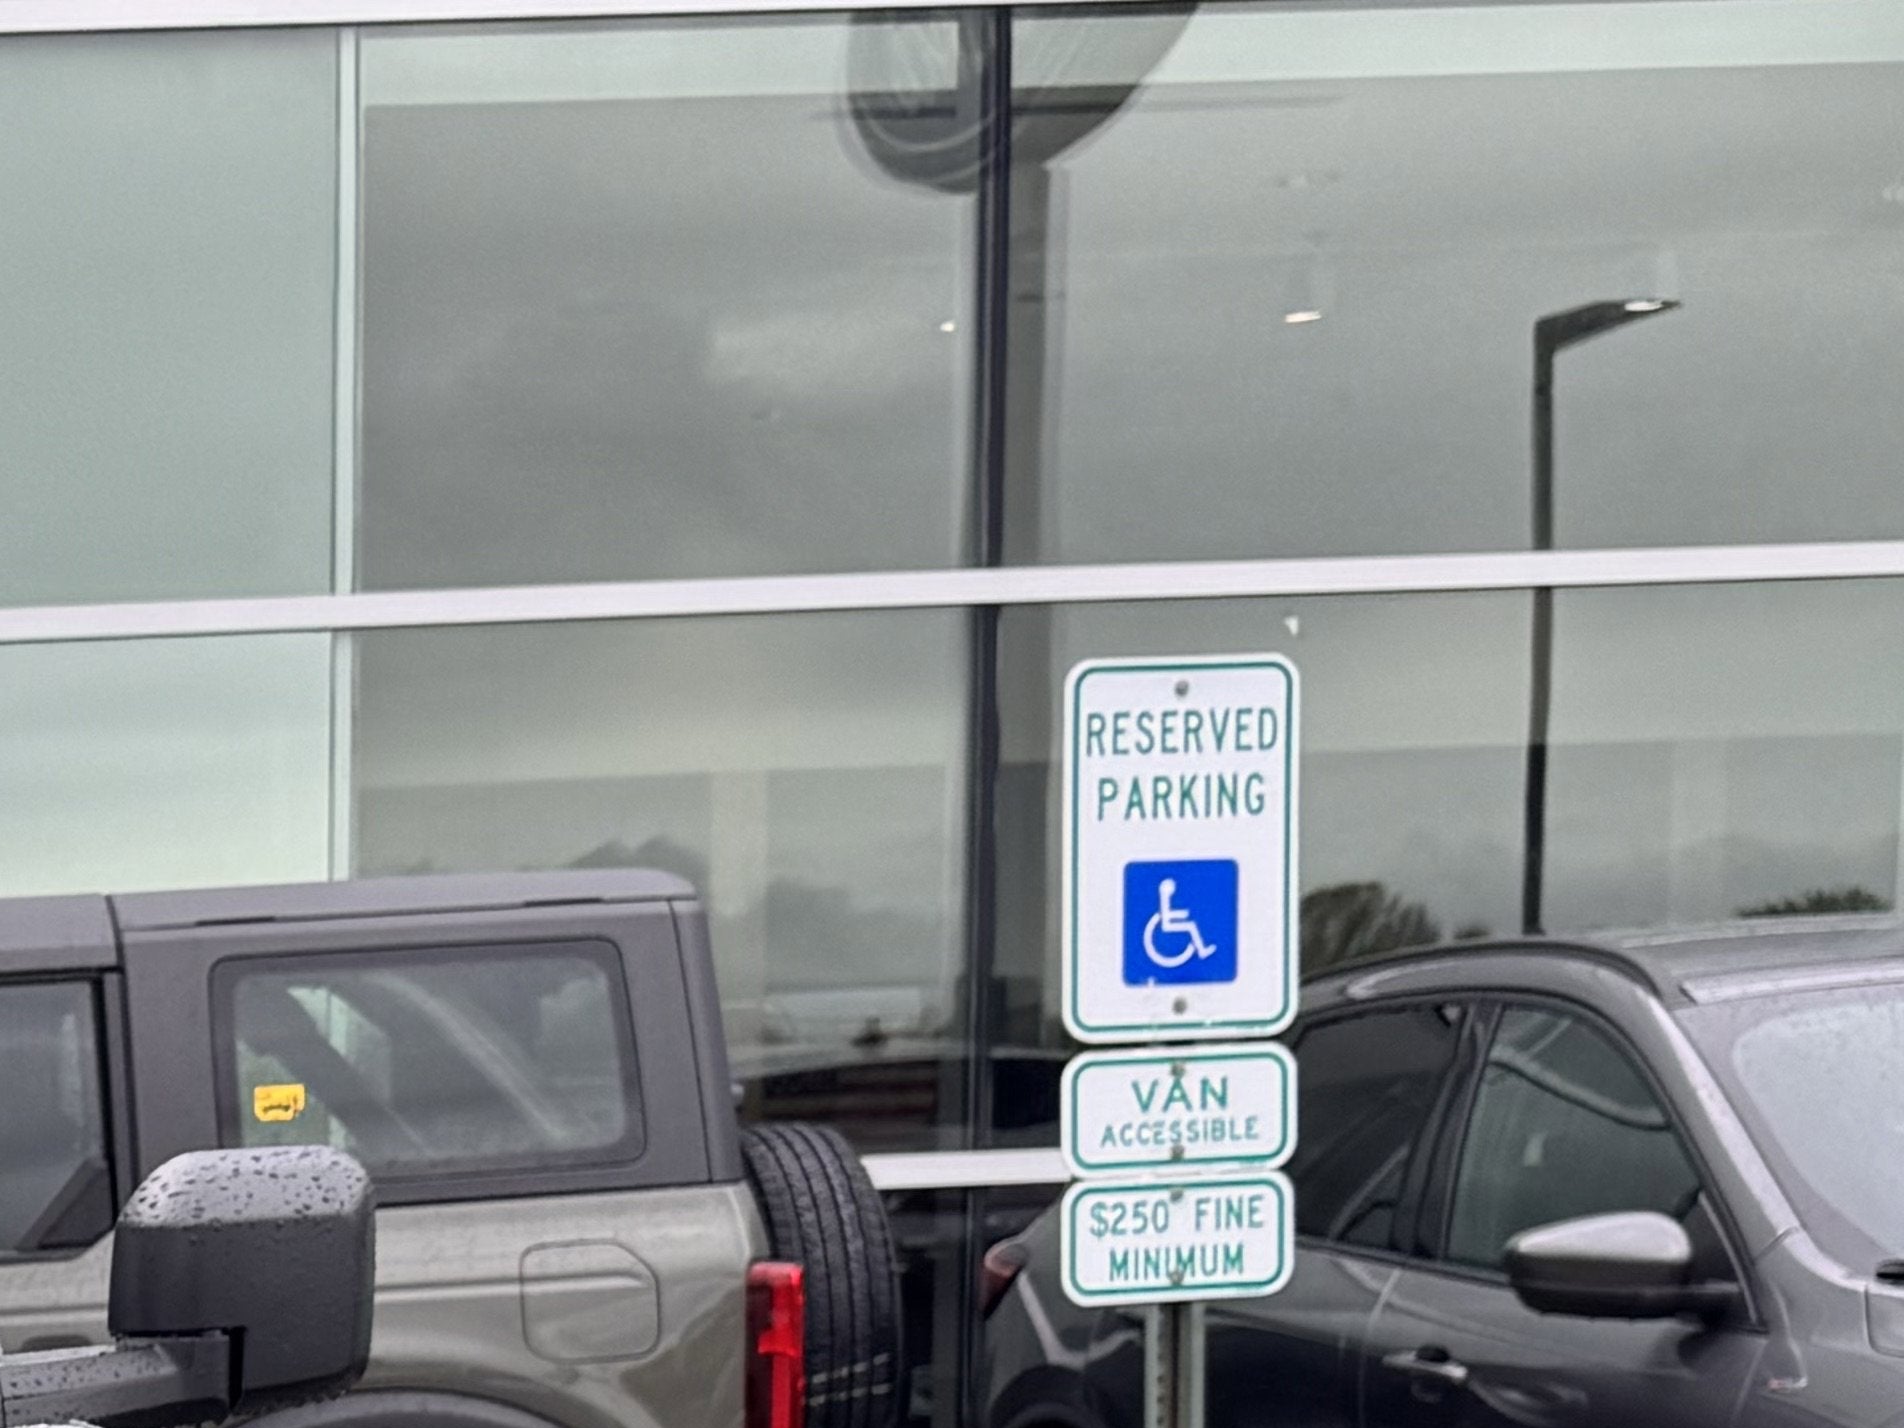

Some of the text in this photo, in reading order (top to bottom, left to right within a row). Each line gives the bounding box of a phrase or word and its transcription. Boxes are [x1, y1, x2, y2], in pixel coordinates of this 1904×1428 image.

[1086, 706, 1278, 757] RESERVED
[1097, 773, 1266, 822] PARKING
[1131, 1075, 1229, 1113] VAN
[1099, 1115, 1260, 1149] ACCESSIBLE
[1088, 1194, 1265, 1238] $250 FINE
[1109, 1243, 1245, 1282] MINIMUM
